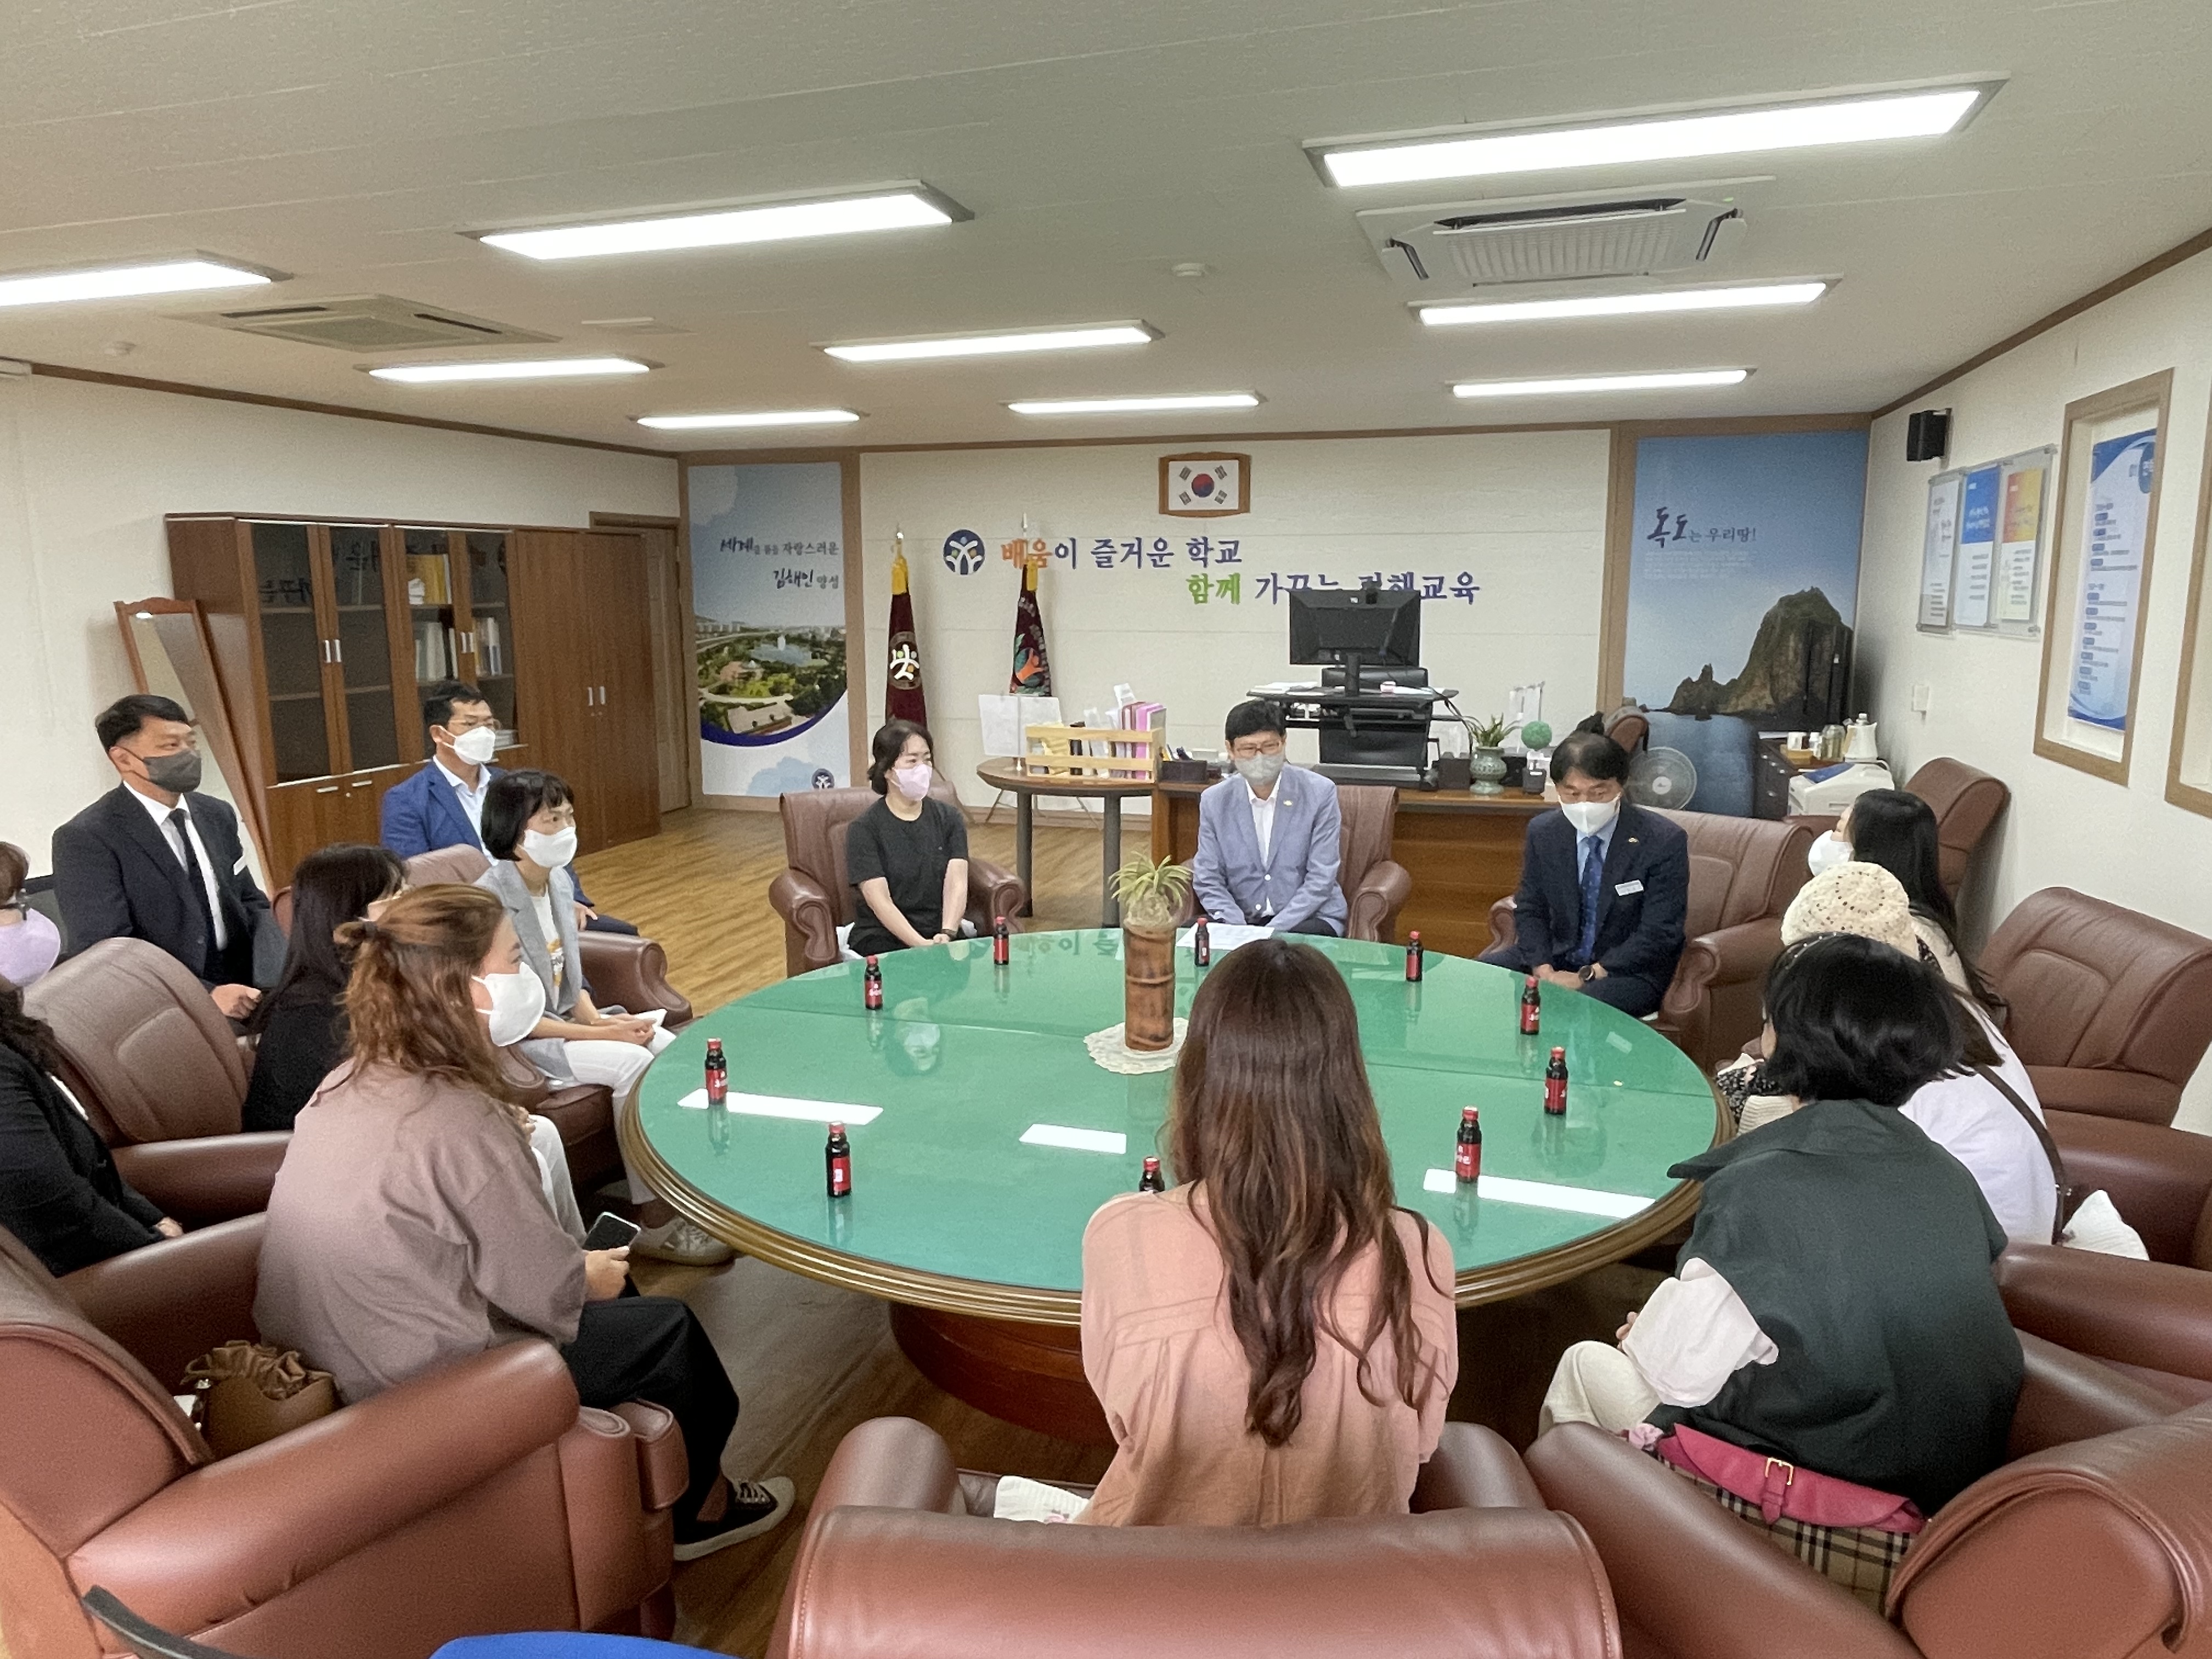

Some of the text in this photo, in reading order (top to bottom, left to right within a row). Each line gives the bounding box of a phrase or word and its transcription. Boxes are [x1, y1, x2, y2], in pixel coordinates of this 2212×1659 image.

[1647, 506, 1701, 548] 독도는
[783, 541, 839, 556] 자랑스러운
[1000, 537, 1242, 569] 배움이 즐거운 학교
[773, 567, 814, 590] 김해인
[1186, 573, 1241, 605] 함께
